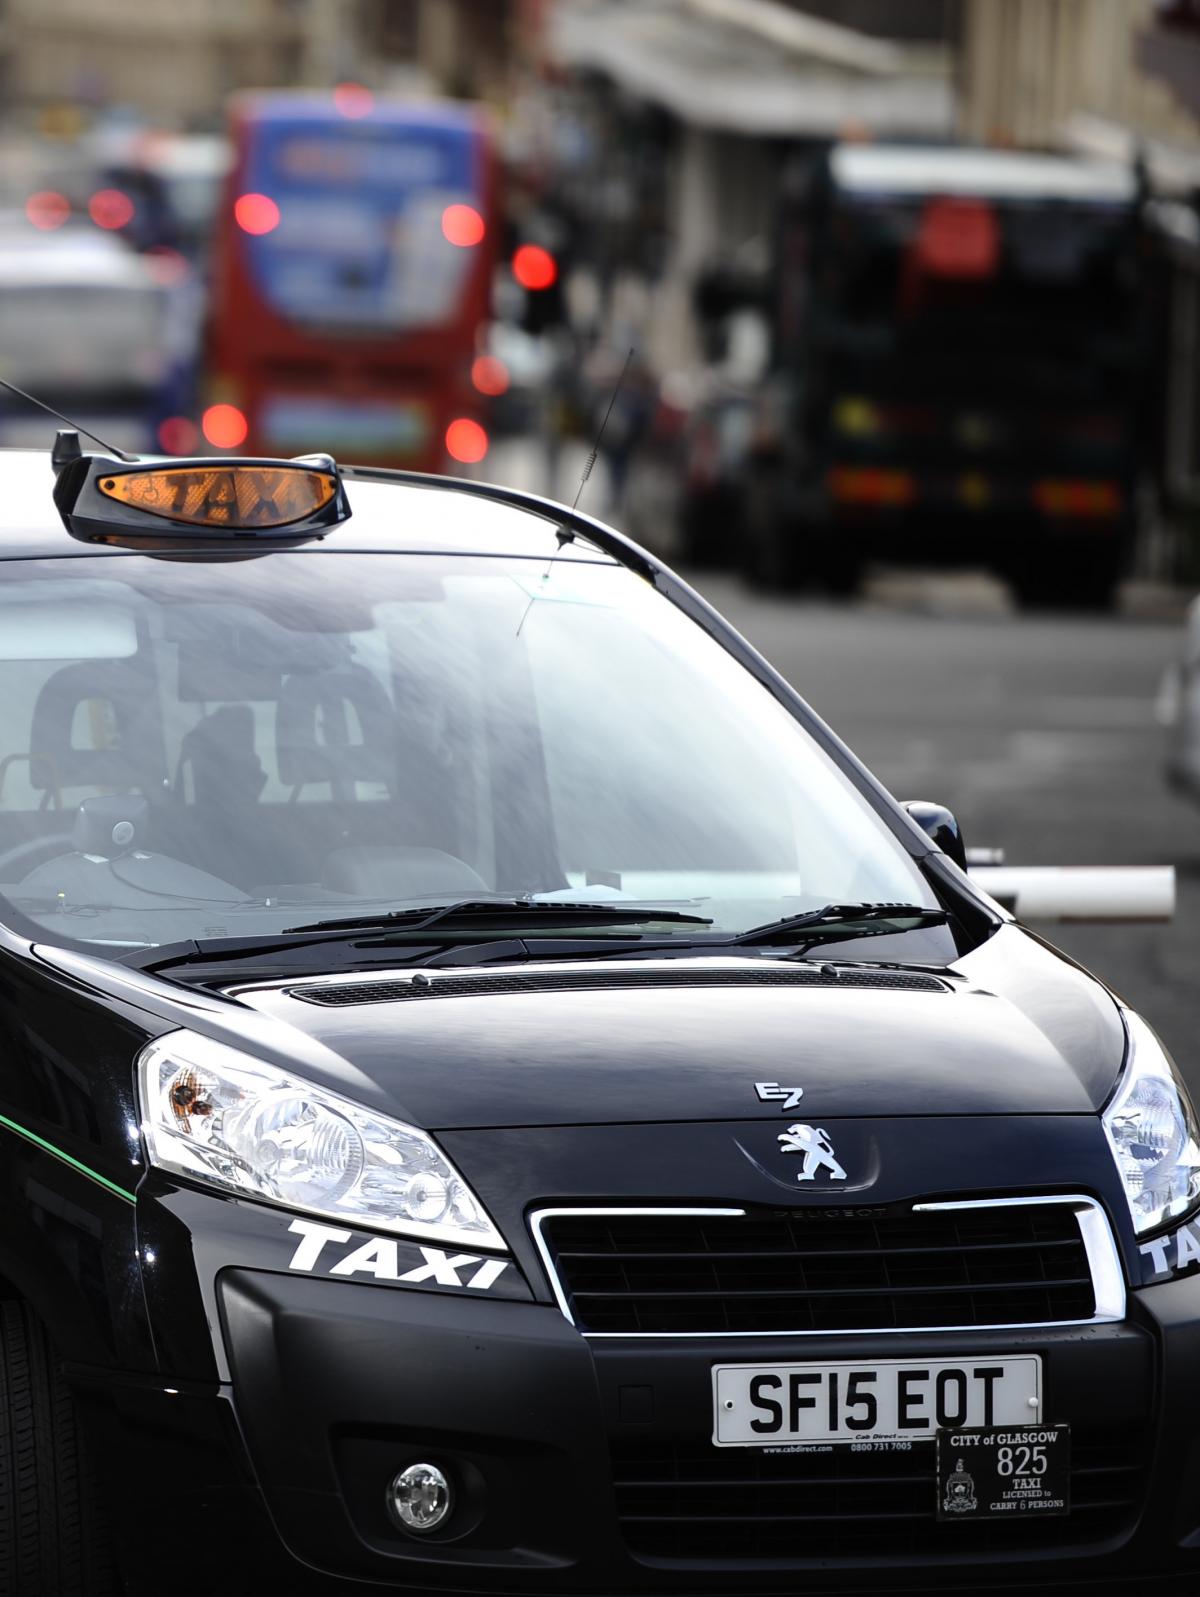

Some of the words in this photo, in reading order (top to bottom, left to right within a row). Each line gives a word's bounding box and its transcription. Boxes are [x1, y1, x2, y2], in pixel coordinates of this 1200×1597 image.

[754, 1082, 804, 1111] E7
[287, 1219, 509, 1290] TAXI
[1139, 1215, 1200, 1275] TA
[749, 1371, 878, 1434] SF15
[897, 1366, 1005, 1429] EOT
[762, 1445, 833, 1454] www.cabdirect.com
[851, 1443, 872, 1452] 0800
[873, 1443, 889, 1451] 731
[891, 1441, 912, 1451] 7005
[950, 1434, 981, 1447] CITY
[983, 1434, 995, 1445] of
[996, 1431, 1058, 1445] GLASGOW
[996, 1446, 1048, 1476] 825
[1002, 1489, 1043, 1499] LICENSED
[1012, 1477, 1041, 1490] TAXI
[990, 1501, 1017, 1511] CARRY
[1019, 1499, 1026, 1511] 6
[1028, 1499, 1064, 1509] PERSONS
